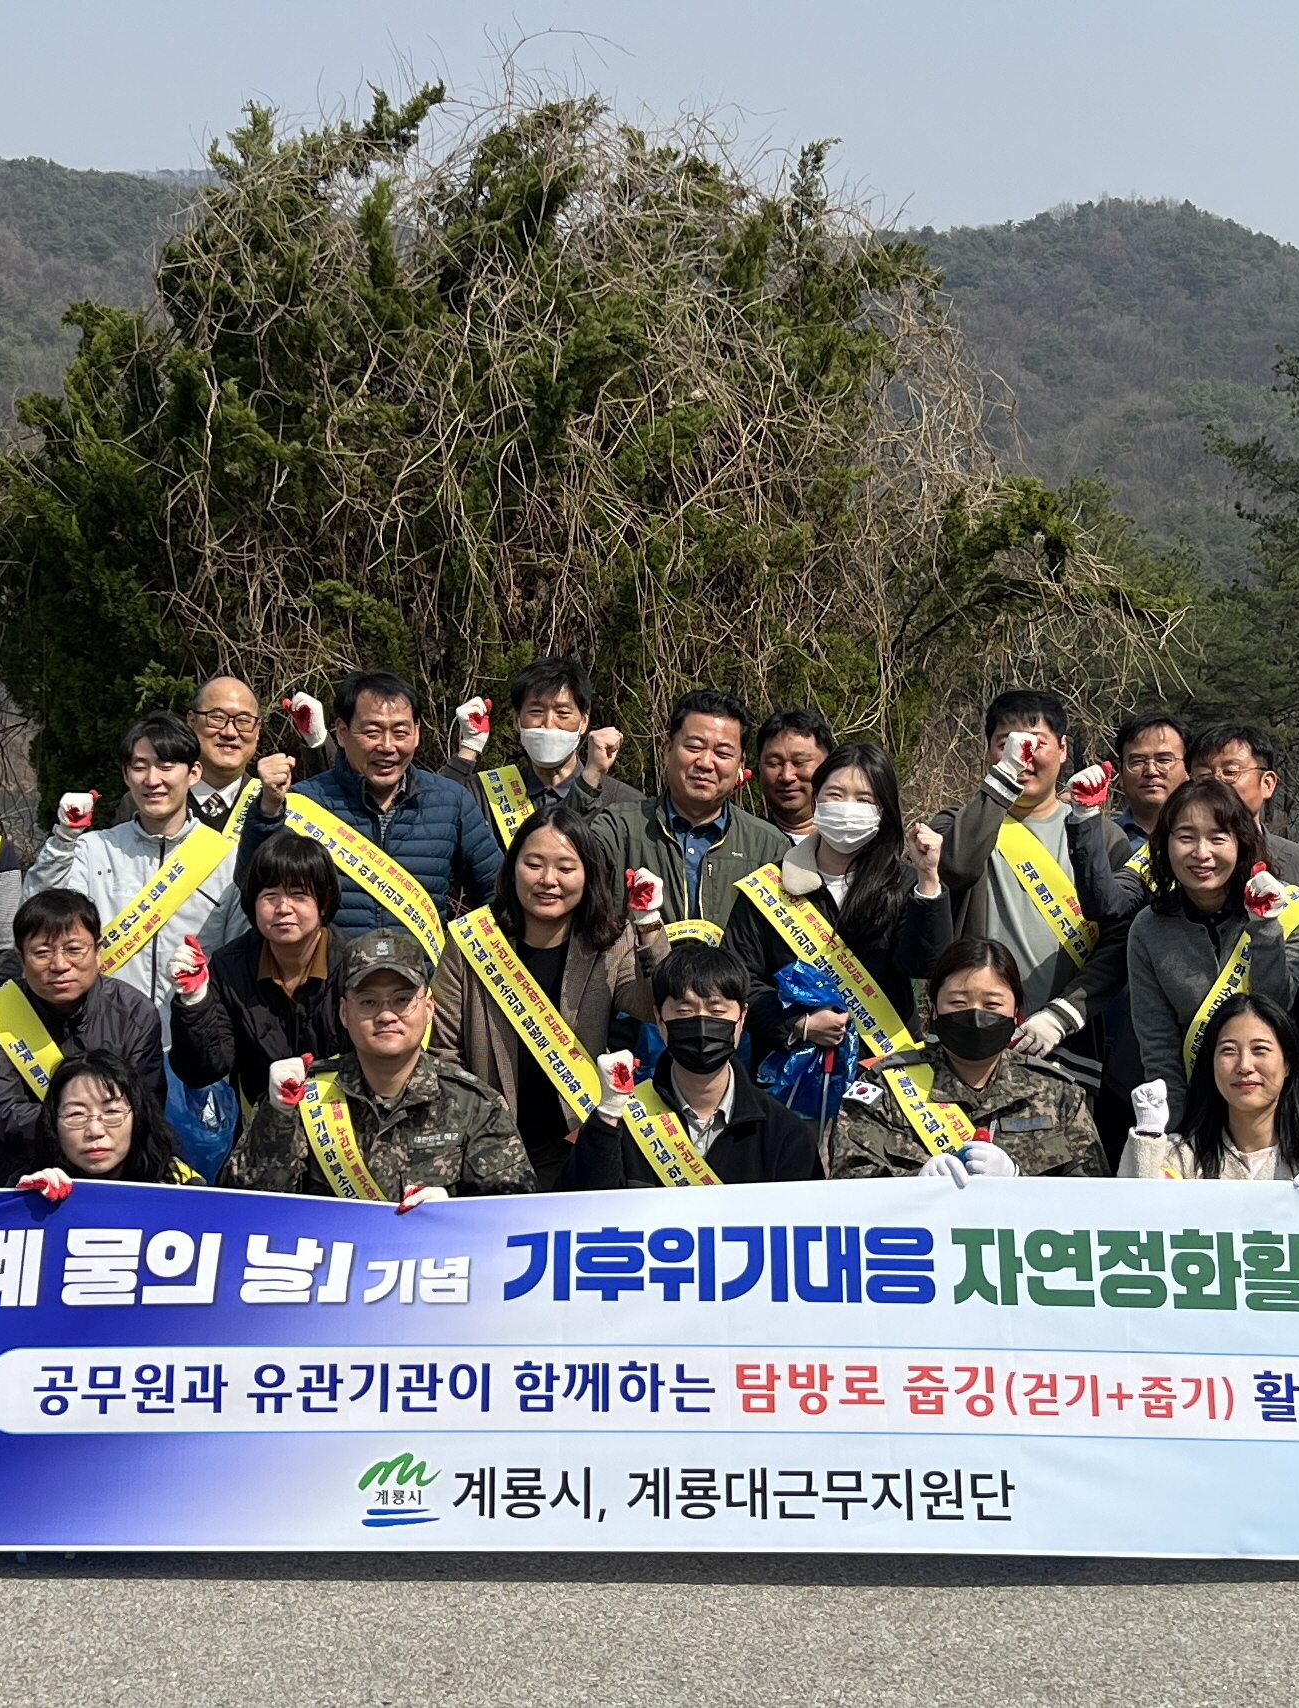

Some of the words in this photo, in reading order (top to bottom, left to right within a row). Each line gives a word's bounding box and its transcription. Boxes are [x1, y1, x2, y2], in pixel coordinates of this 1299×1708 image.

[60, 1228, 223, 1307] 물의
[239, 1233, 357, 1306] 날」
[362, 1255, 471, 1307] 기념
[503, 1226, 936, 1304] 기후위기대응
[32, 1364, 229, 1415] 공무원과
[246, 1362, 490, 1414] 유관기관이
[513, 1360, 716, 1413] 함께하는
[735, 1363, 886, 1417] 탐방로
[903, 1364, 1233, 1422] 줍깅(걷기+줍기)
[375, 1490, 421, 1505] 계룡시
[452, 1466, 607, 1521] 계룡시,
[626, 1466, 1014, 1522] 계룡대근무지원단
